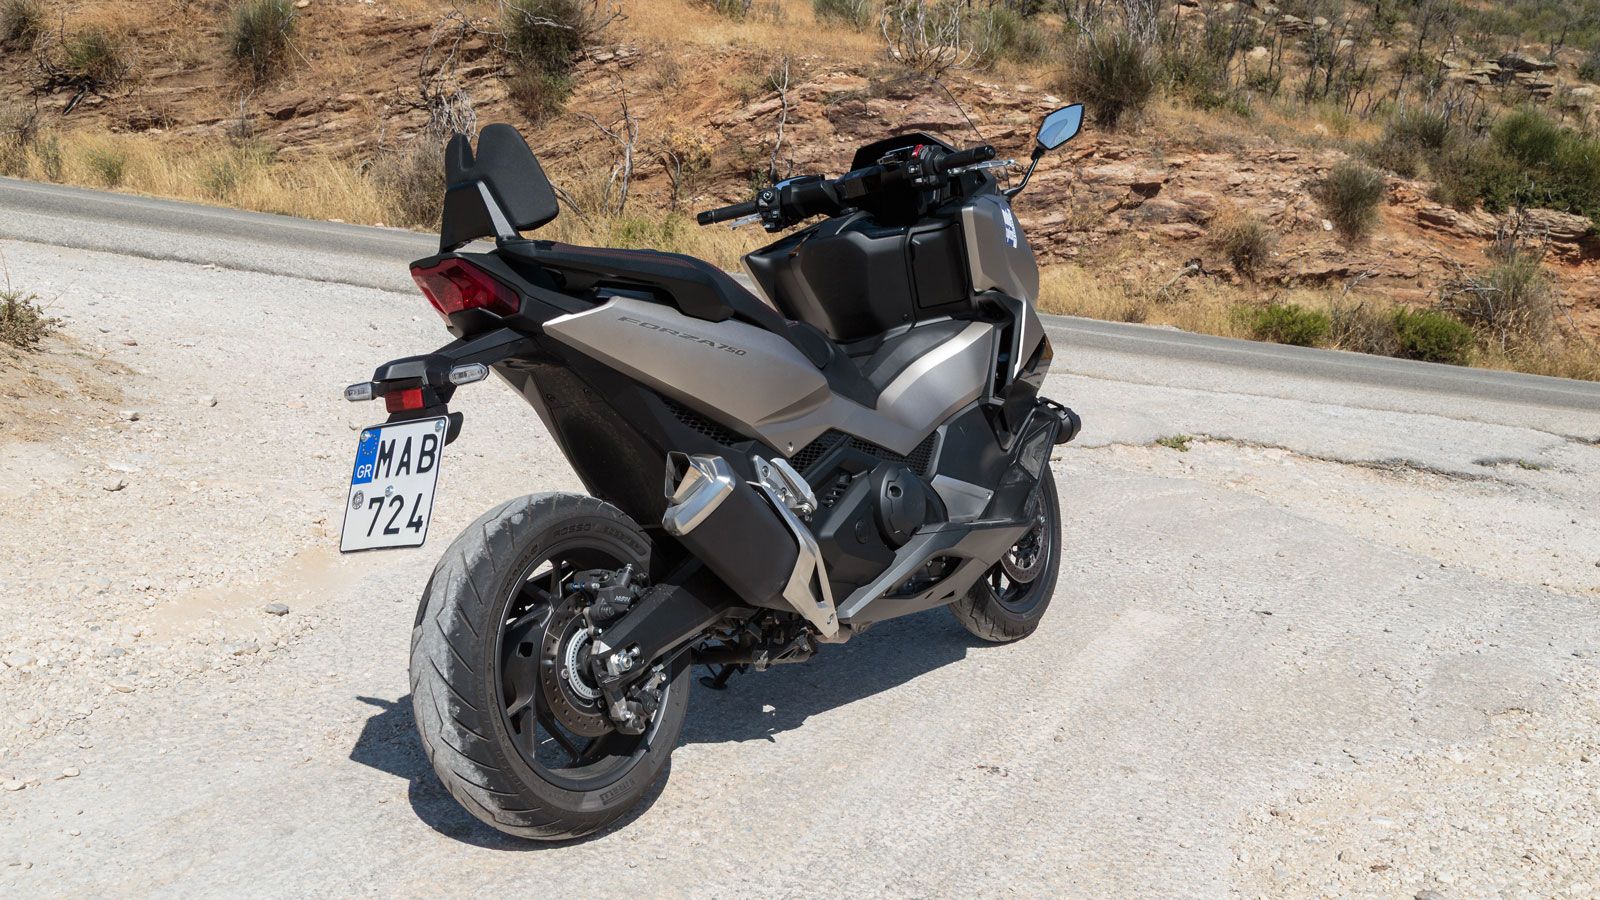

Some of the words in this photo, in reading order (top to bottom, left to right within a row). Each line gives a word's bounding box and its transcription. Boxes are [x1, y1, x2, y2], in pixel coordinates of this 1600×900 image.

[617, 315, 716, 348] FORZA
[716, 342, 748, 357] 750
[356, 463, 373, 479] GR
[374, 433, 438, 480] MAB
[366, 492, 423, 538] 724
